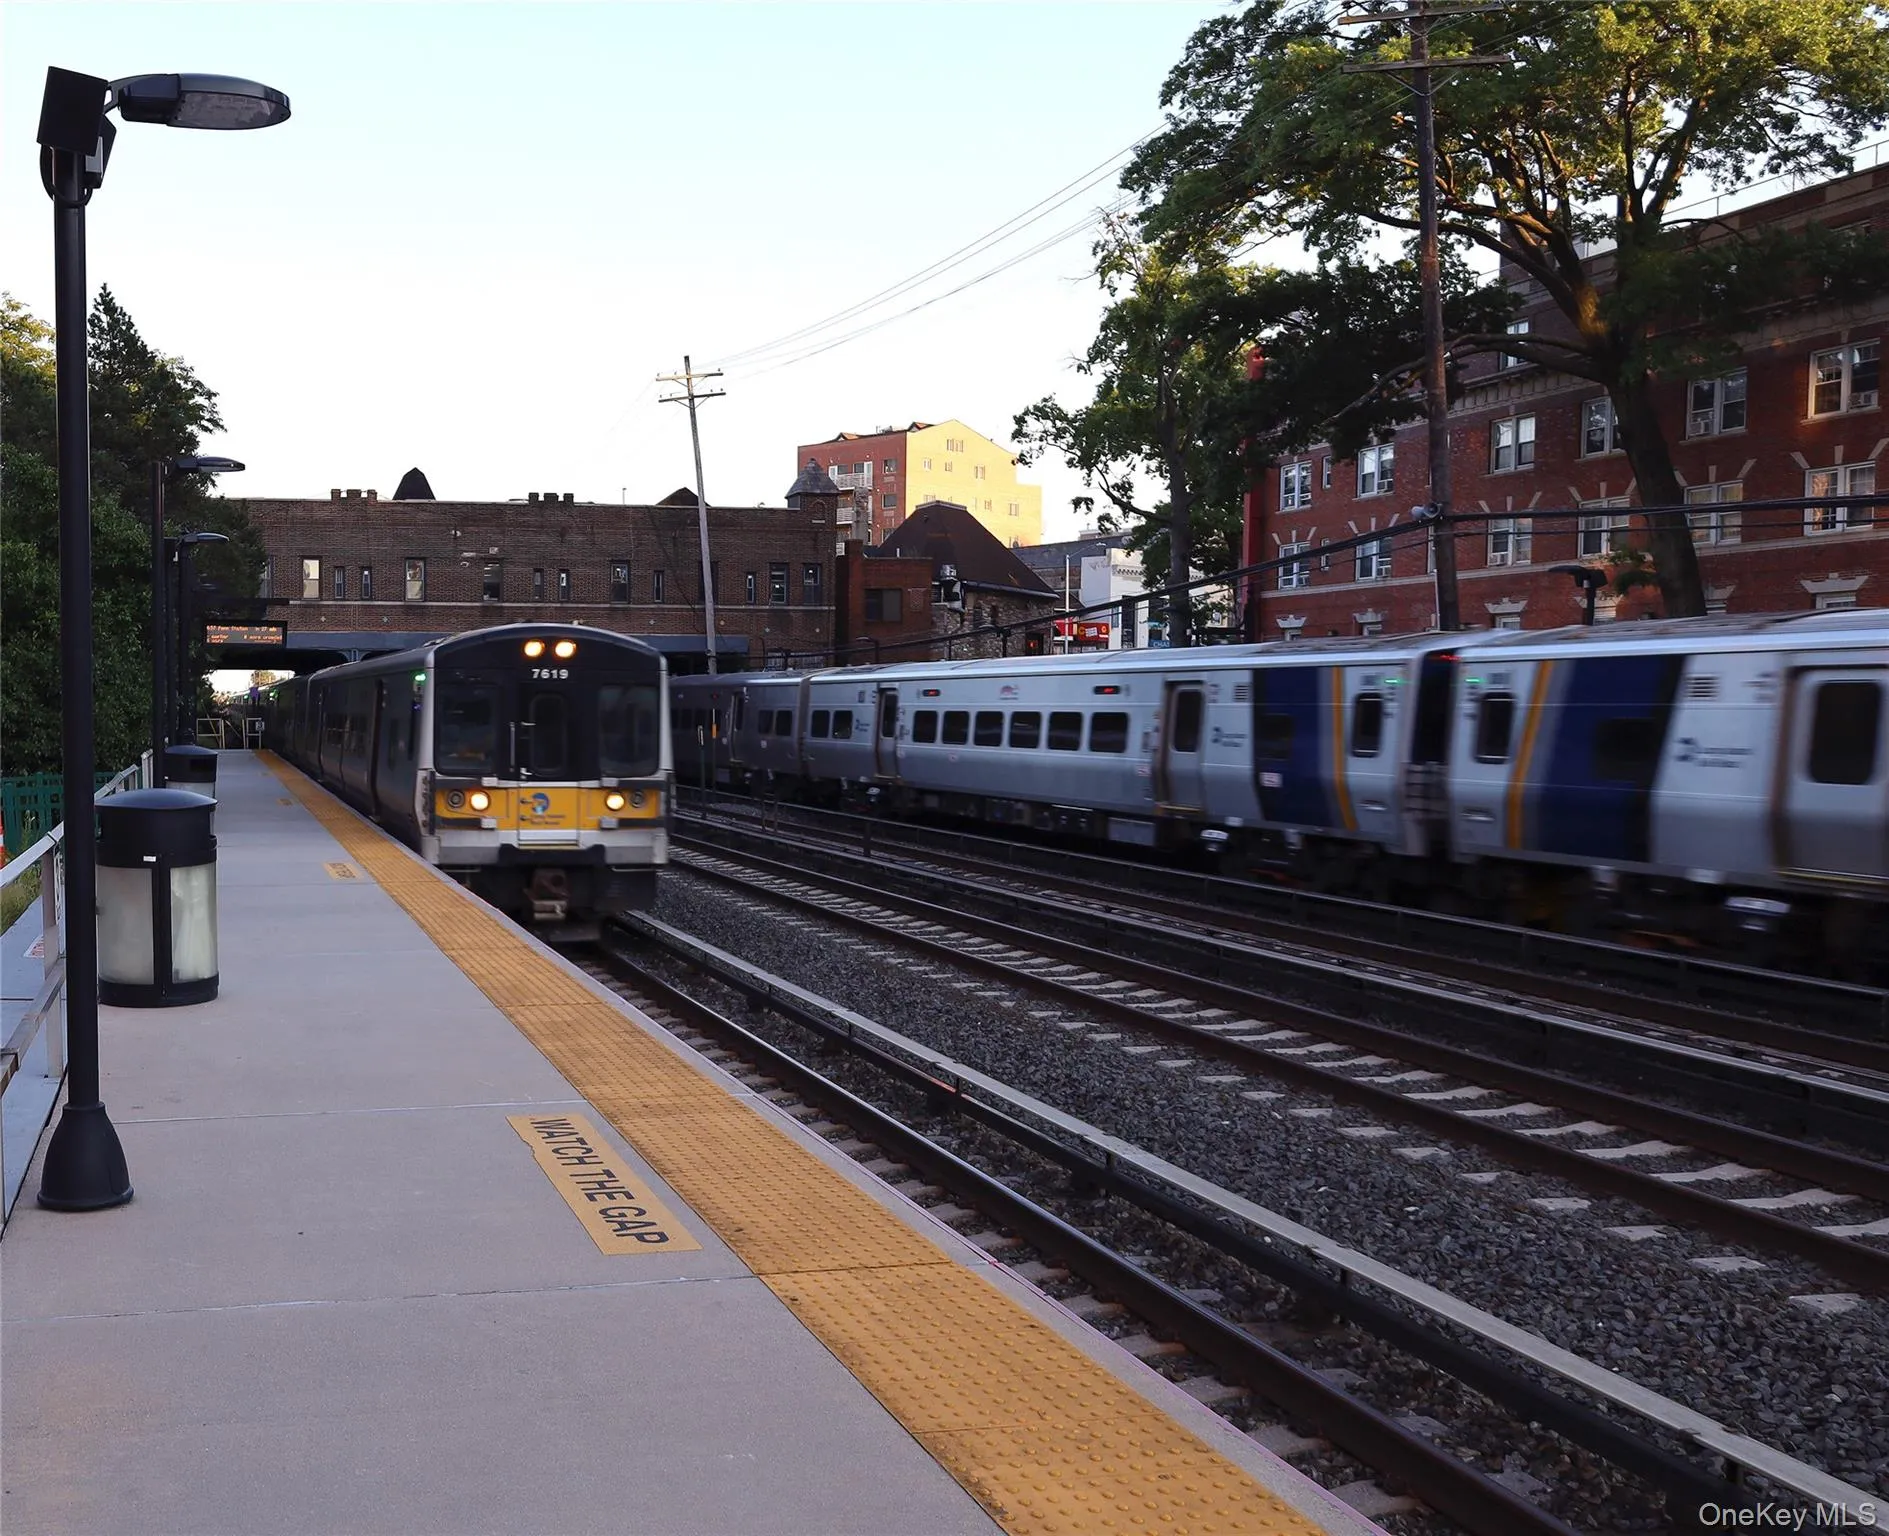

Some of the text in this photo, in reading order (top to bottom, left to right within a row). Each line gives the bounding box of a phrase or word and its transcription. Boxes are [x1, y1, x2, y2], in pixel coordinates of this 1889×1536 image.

[531, 668, 569, 679] 7619
[530, 1118, 670, 1244] WATCH THE GAP
